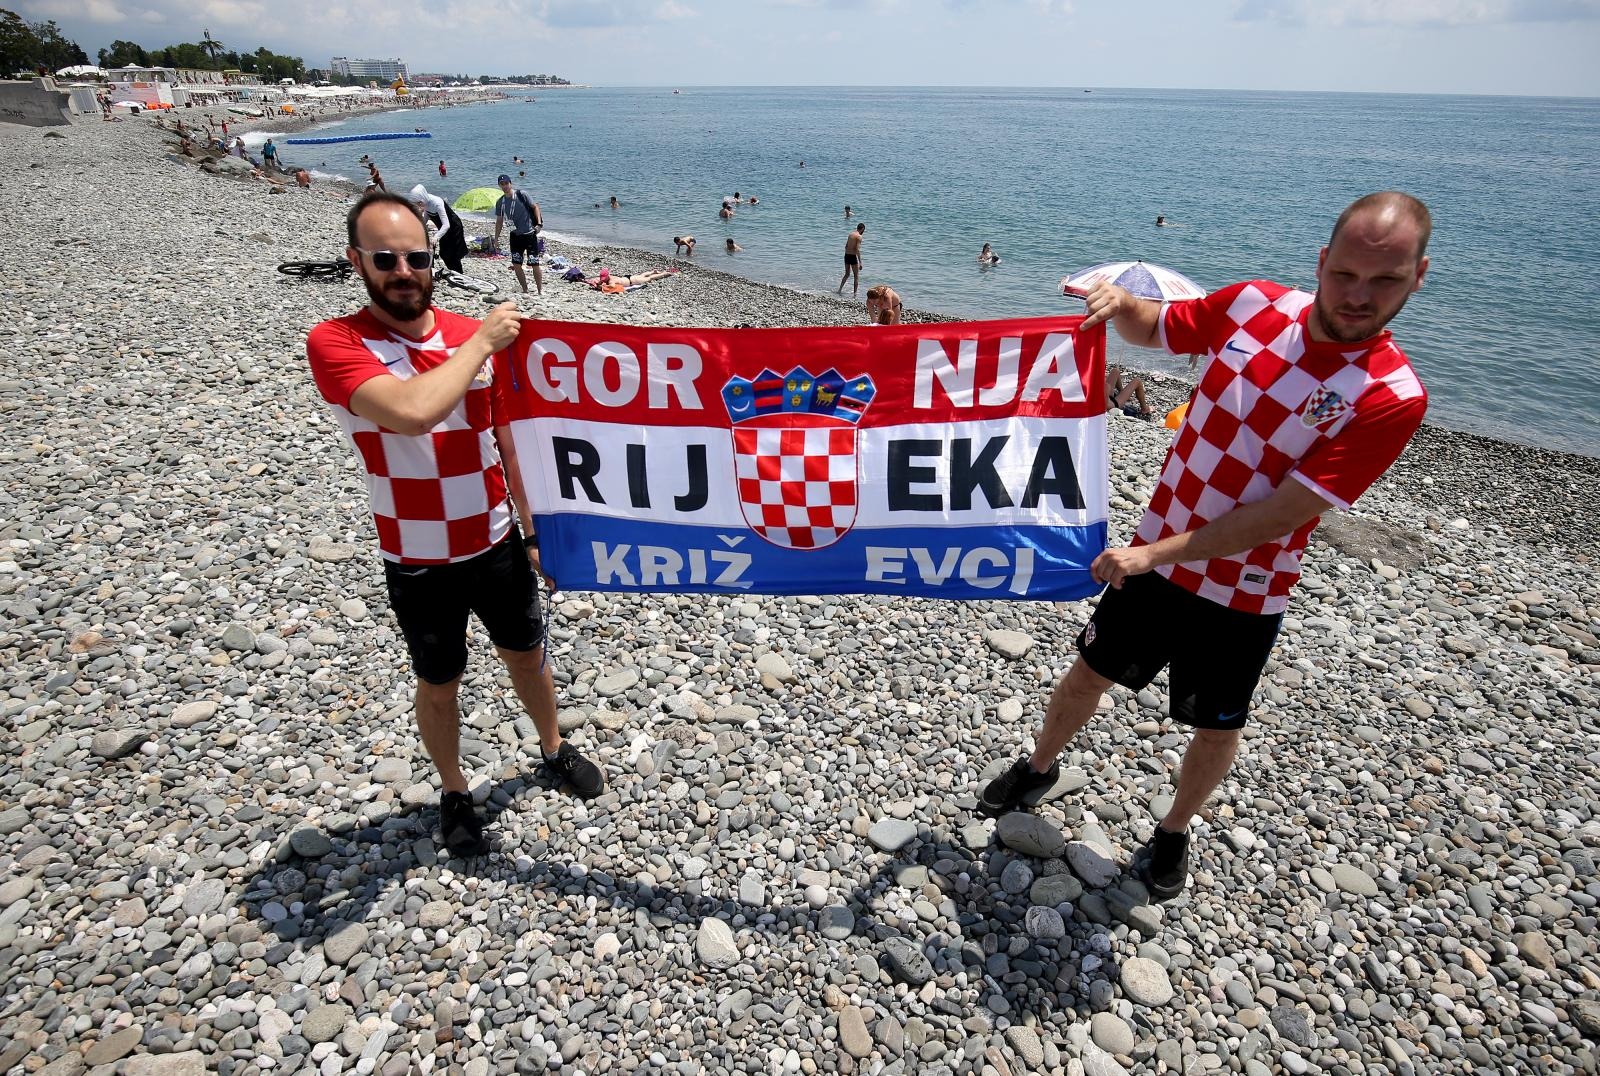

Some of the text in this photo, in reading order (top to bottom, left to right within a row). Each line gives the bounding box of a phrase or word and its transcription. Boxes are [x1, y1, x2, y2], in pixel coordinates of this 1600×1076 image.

[526, 333, 1087, 410] GOR NJA
[887, 434, 1087, 512] EKA
[591, 534, 1035, 596] KRIŽ EVCI
